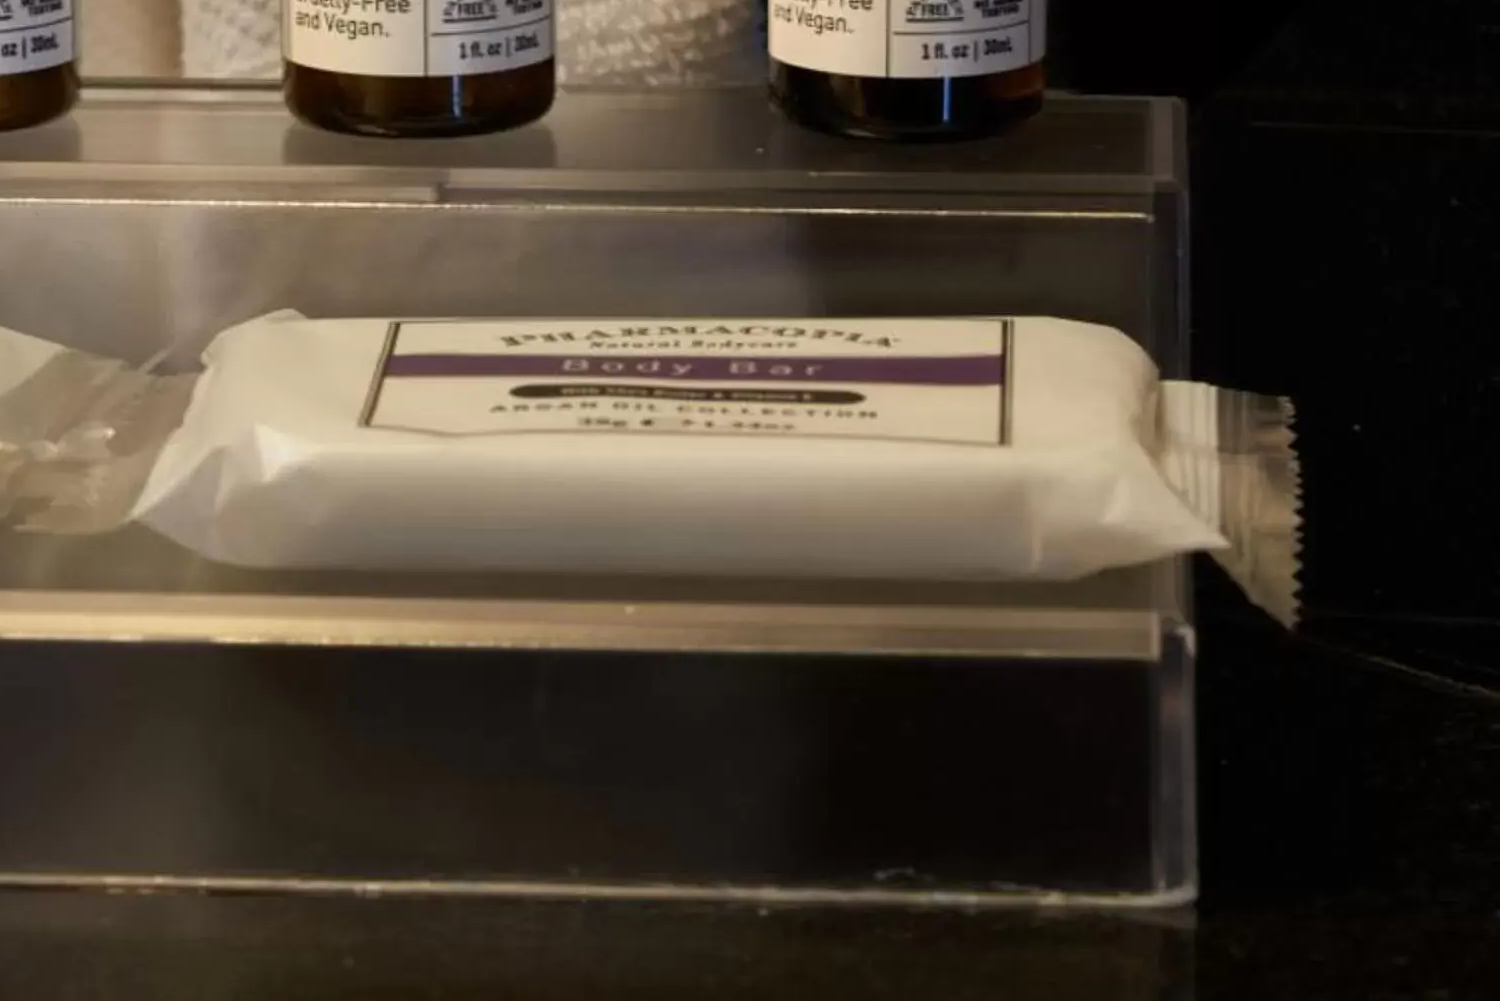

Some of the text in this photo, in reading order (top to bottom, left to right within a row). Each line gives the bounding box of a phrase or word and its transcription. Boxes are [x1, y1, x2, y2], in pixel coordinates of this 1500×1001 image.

[295, 11, 390, 39] and Vegan.
[774, 4, 855, 34] and Vegan.
[460, 42, 466, 59] 1
[922, 43, 929, 59] 1
[562, 359, 822, 376] Body Bar
